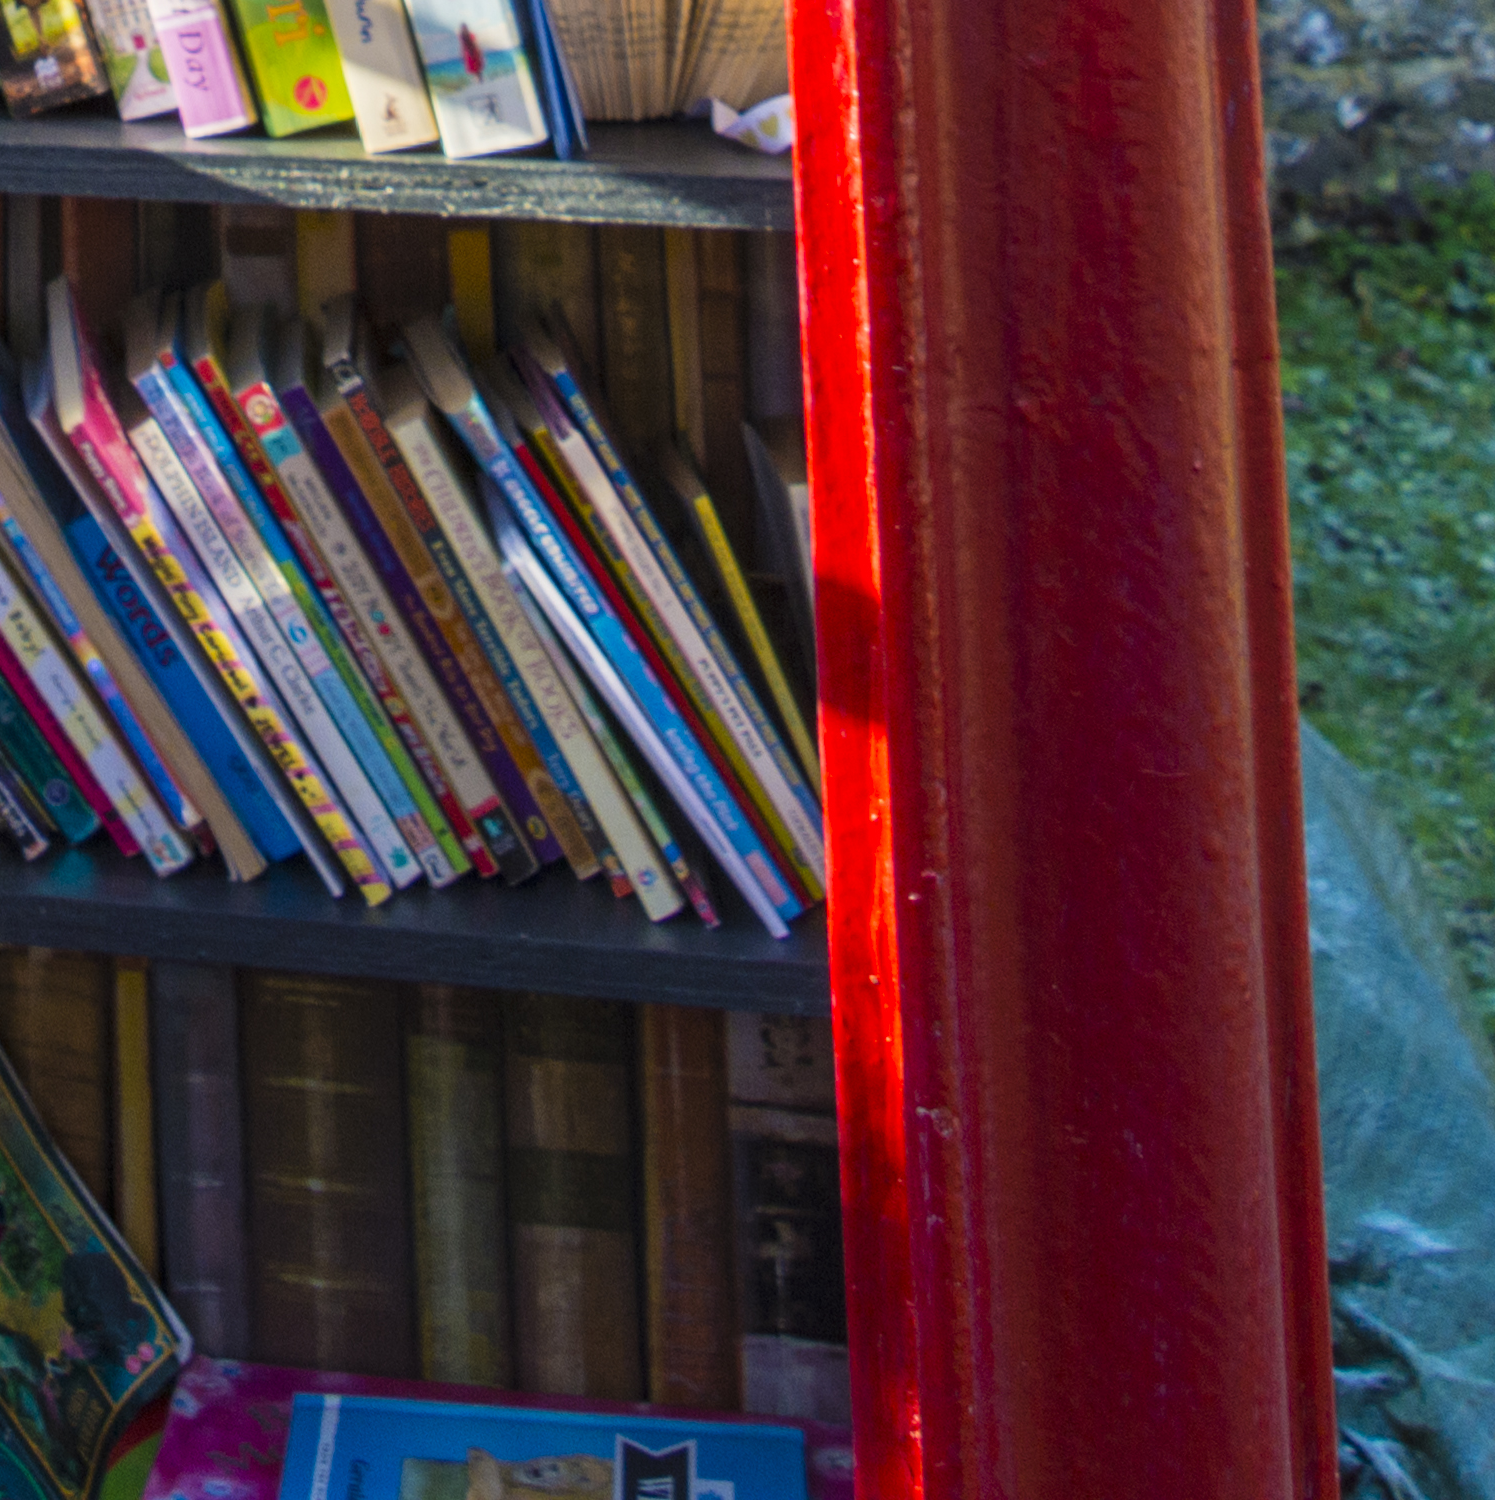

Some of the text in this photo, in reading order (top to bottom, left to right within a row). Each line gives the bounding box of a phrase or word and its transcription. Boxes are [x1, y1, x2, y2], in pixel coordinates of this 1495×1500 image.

[171, 26, 215, 95] Day
[136, 431, 208, 523] DOLPHIN
[189, 515, 250, 591] ISLAND
[88, 541, 186, 668] Words
